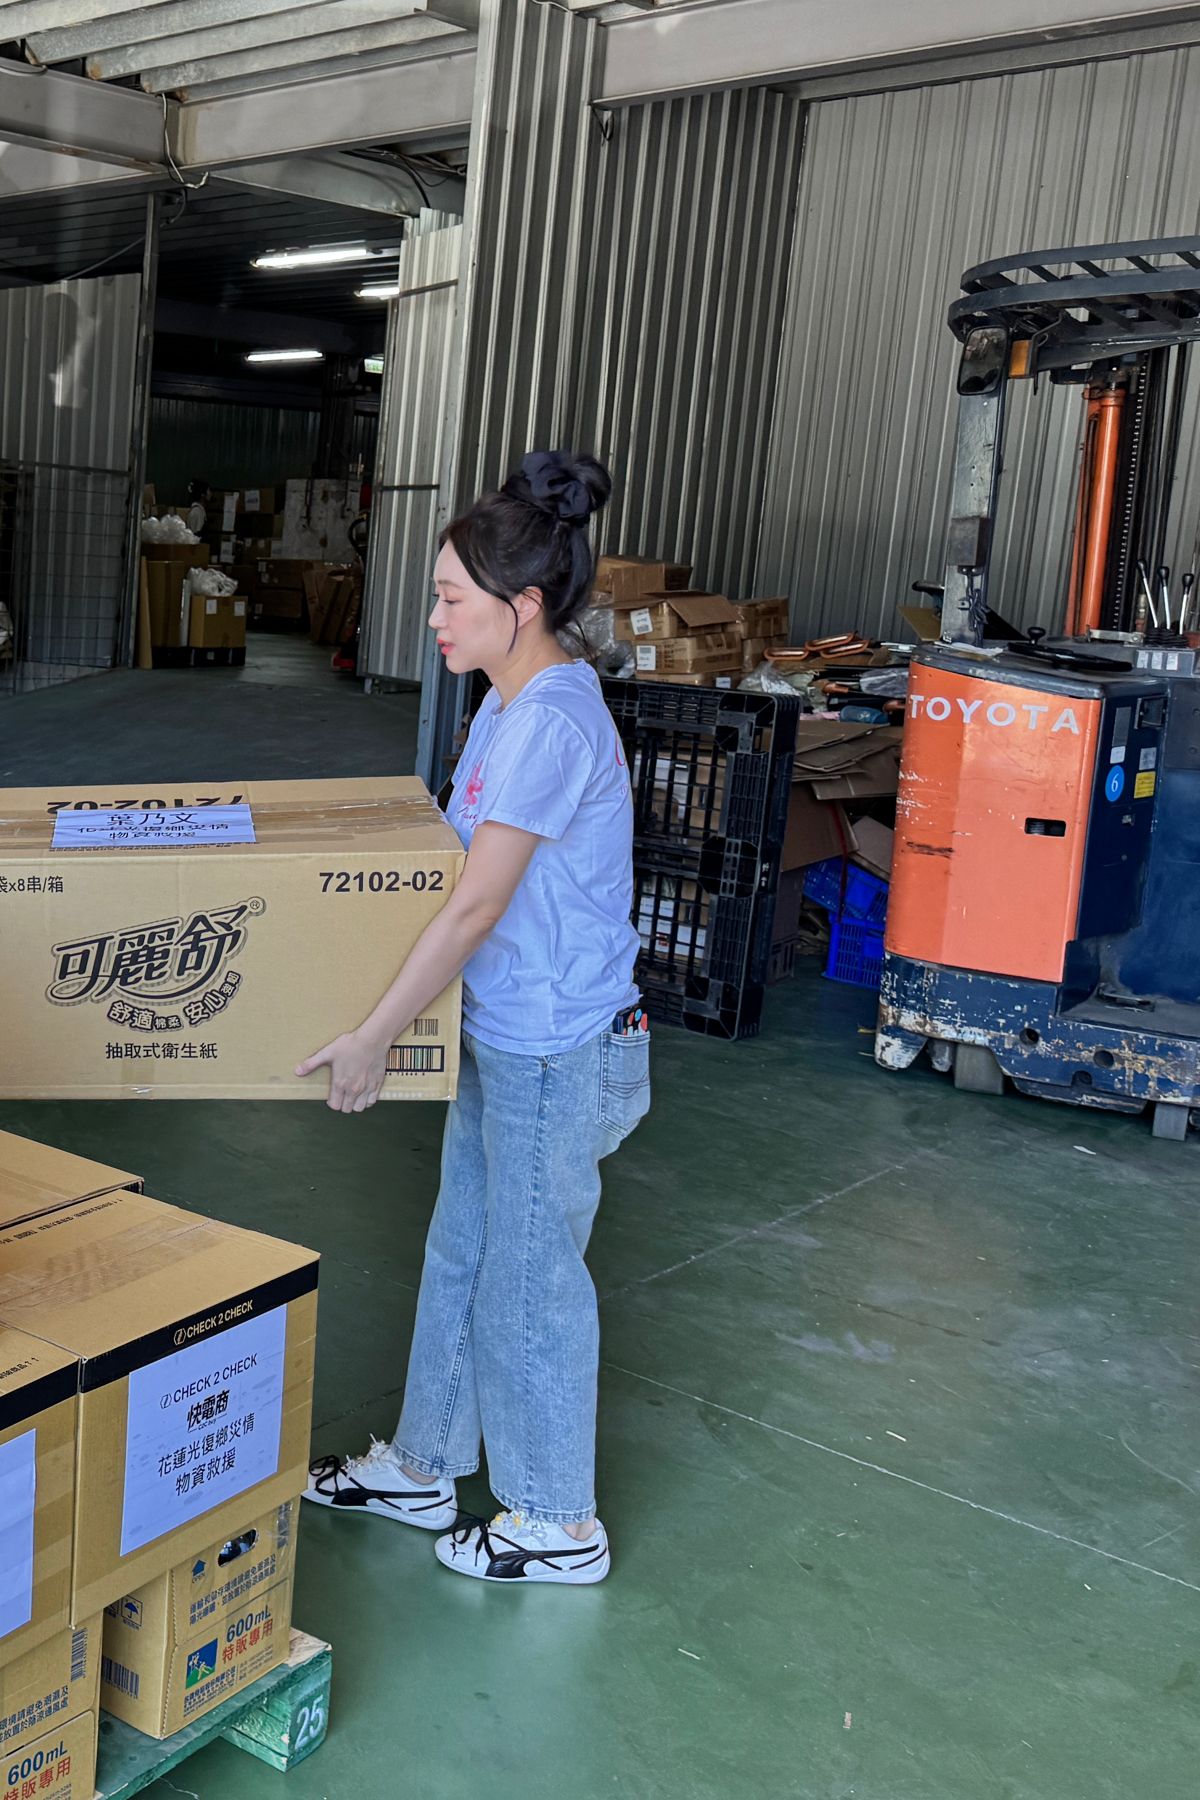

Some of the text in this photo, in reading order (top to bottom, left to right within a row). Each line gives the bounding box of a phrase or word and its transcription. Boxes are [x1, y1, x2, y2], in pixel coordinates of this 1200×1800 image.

[909, 694, 1080, 735] TOYOTA
[1111, 773, 1120, 792] 6
[107, 812, 199, 825] 葉乃文
[319, 870, 443, 892] 72102-02
[50, 903, 248, 999] 可麗舒
[106, 1042, 218, 1059] 抽取式衛生紙
[186, 1299, 254, 1338] CHECK 2 CHECK
[173, 1352, 258, 1403] CHECK 2 CHECK
[186, 1389, 230, 1430] 快電商
[158, 1412, 255, 1478] 花蓮光復鄉災情
[175, 1447, 236, 1497] 物資救援
[222, 1618, 273, 1664] 特販專用
[295, 1694, 323, 1750] 25
